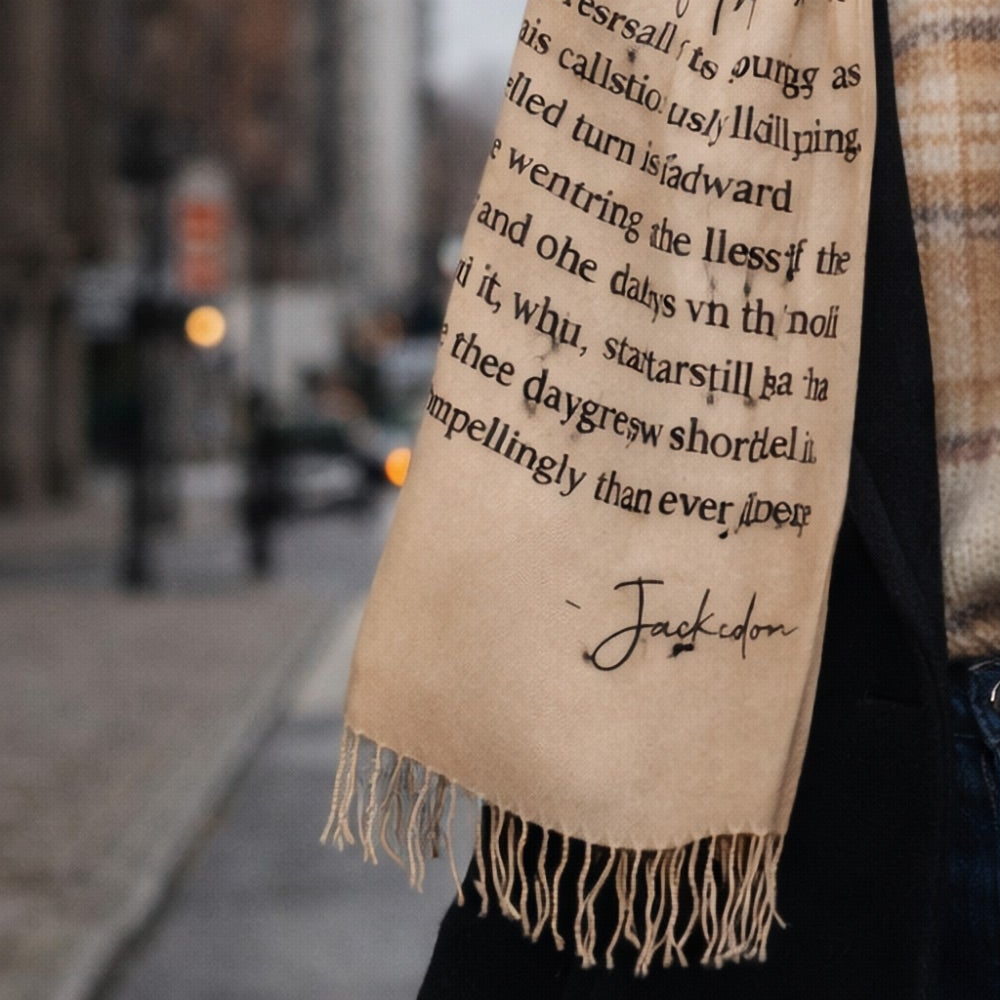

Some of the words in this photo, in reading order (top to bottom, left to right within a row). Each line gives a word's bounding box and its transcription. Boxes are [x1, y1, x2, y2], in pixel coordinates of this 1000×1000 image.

[832, 63, 862, 90] as
[572, 113, 636, 165] turn
[508, 147, 643, 244] wentring
[476, 201, 533, 247] and
[536, 234, 598, 284] ohe
[594, 470, 652, 515] than
